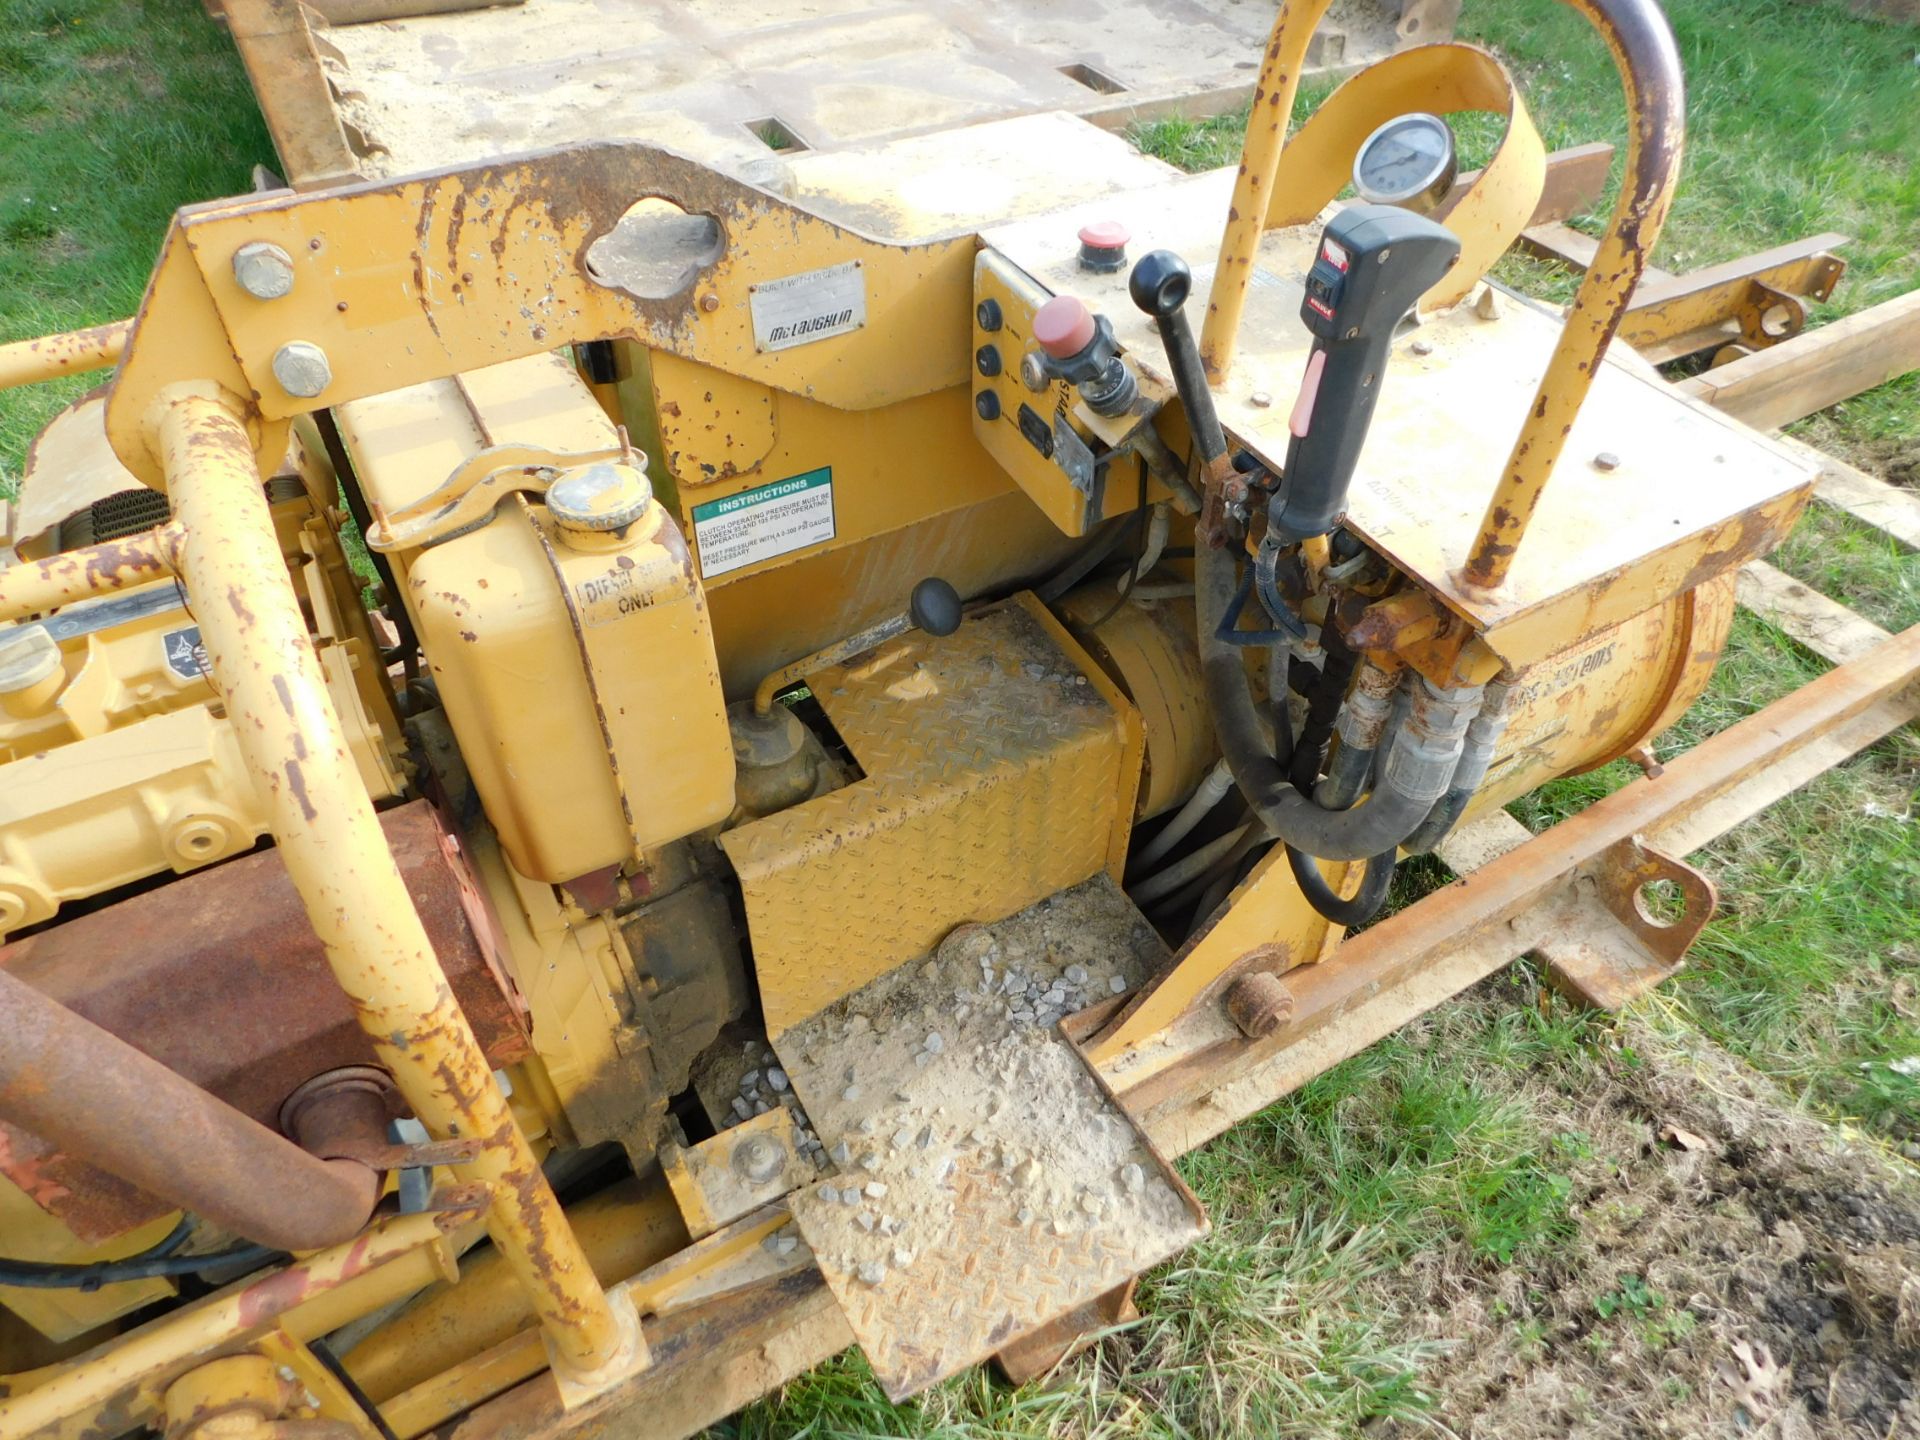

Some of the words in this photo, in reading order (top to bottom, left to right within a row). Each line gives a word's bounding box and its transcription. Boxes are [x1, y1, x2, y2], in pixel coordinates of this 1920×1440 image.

[700, 524, 726, 537] CLUTCH
[727, 511, 764, 528] OPERATING
[766, 500, 800, 516] PRESSURE
[802, 495, 820, 505] MUST
[719, 479, 807, 512] INSTRUCTIONS
[701, 528, 733, 543] BETWEEN
[743, 520, 757, 530] AND
[770, 513, 781, 521] PSI
[791, 498, 828, 515] OPERATING
[703, 550, 723, 561] RESET
[725, 538, 757, 554] PRESSURE
[760, 533, 774, 543] WITH
[809, 516, 831, 528] GAUGE
[711, 547, 750, 565] NECESSARY
